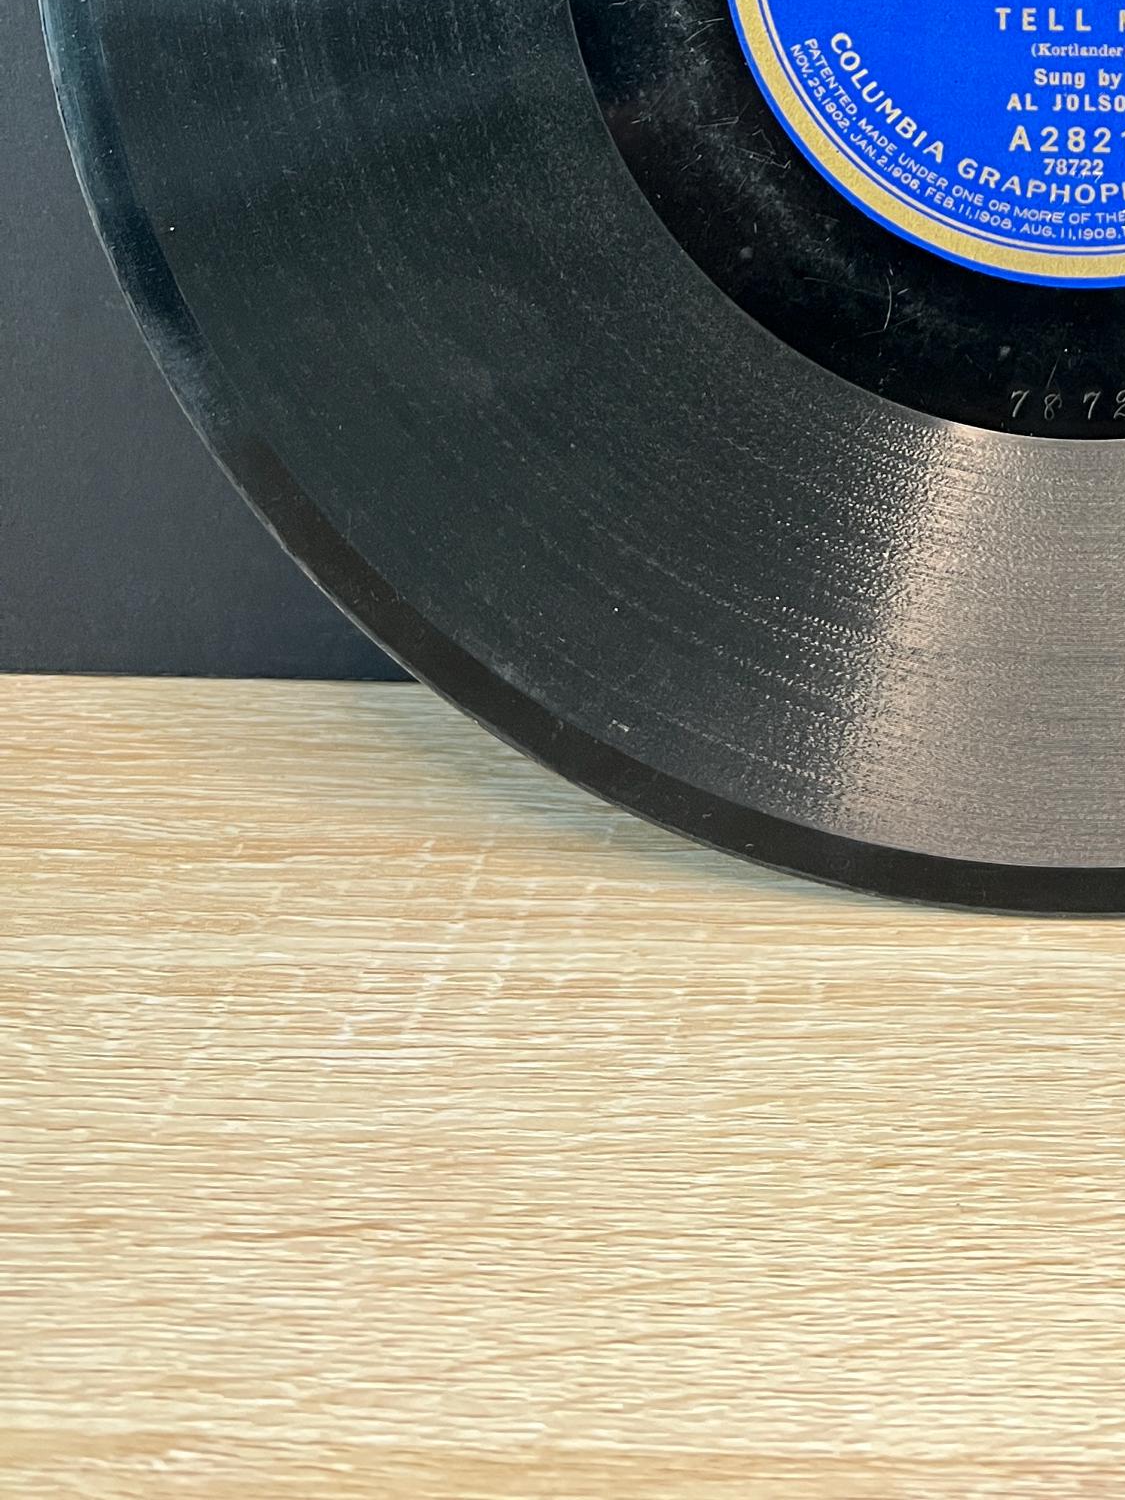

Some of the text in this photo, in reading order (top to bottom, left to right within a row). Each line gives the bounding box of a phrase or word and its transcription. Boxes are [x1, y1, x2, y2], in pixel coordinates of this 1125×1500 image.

[996, 8, 1091, 31] TELL
[1035, 69, 1121, 89] Sung by
[831, 33, 943, 163] COLUMBIA
[1007, 91, 1039, 112] AL
[858, 118, 897, 155] MADE
[899, 154, 948, 189] UNDER
[952, 186, 983, 205] ONE
[989, 200, 1010, 212] OR
[1014, 207, 1064, 223] MORE
[1069, 213, 1090, 224] OF
[1042, 158, 1103, 177] 78722
